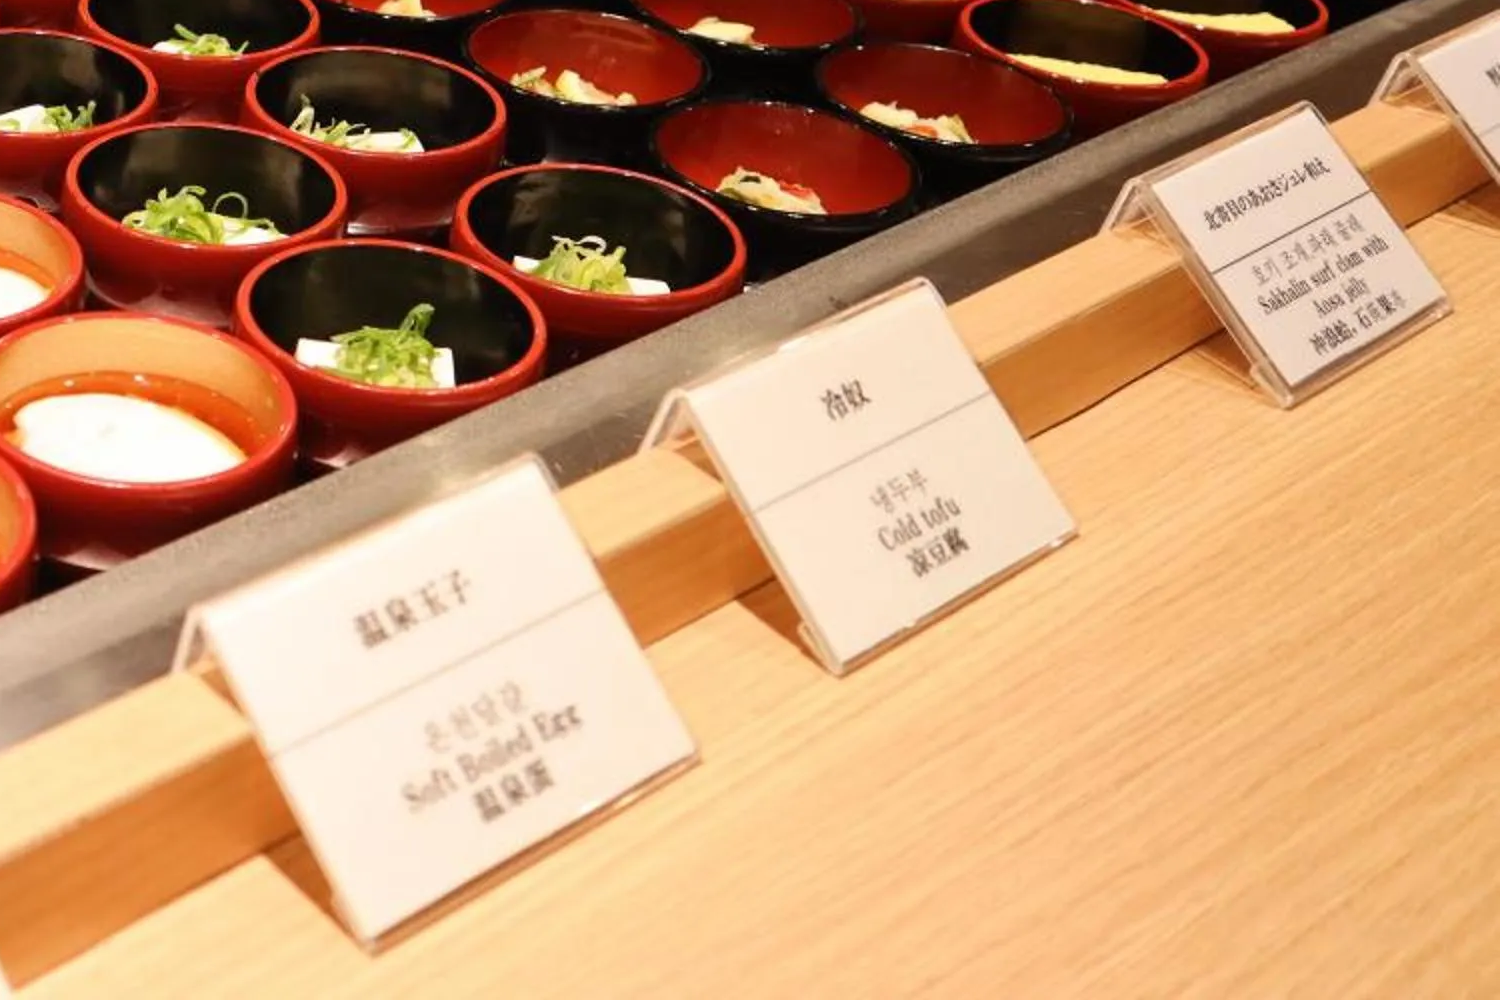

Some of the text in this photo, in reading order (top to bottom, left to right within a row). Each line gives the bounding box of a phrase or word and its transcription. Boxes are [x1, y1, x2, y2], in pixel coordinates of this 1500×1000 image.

[1257, 233, 1390, 316] Sakhalin surf clam with
[819, 379, 872, 421] 冷奴
[877, 496, 962, 551] Cold tofu
[401, 704, 583, 815] Soft Boiled Egg
